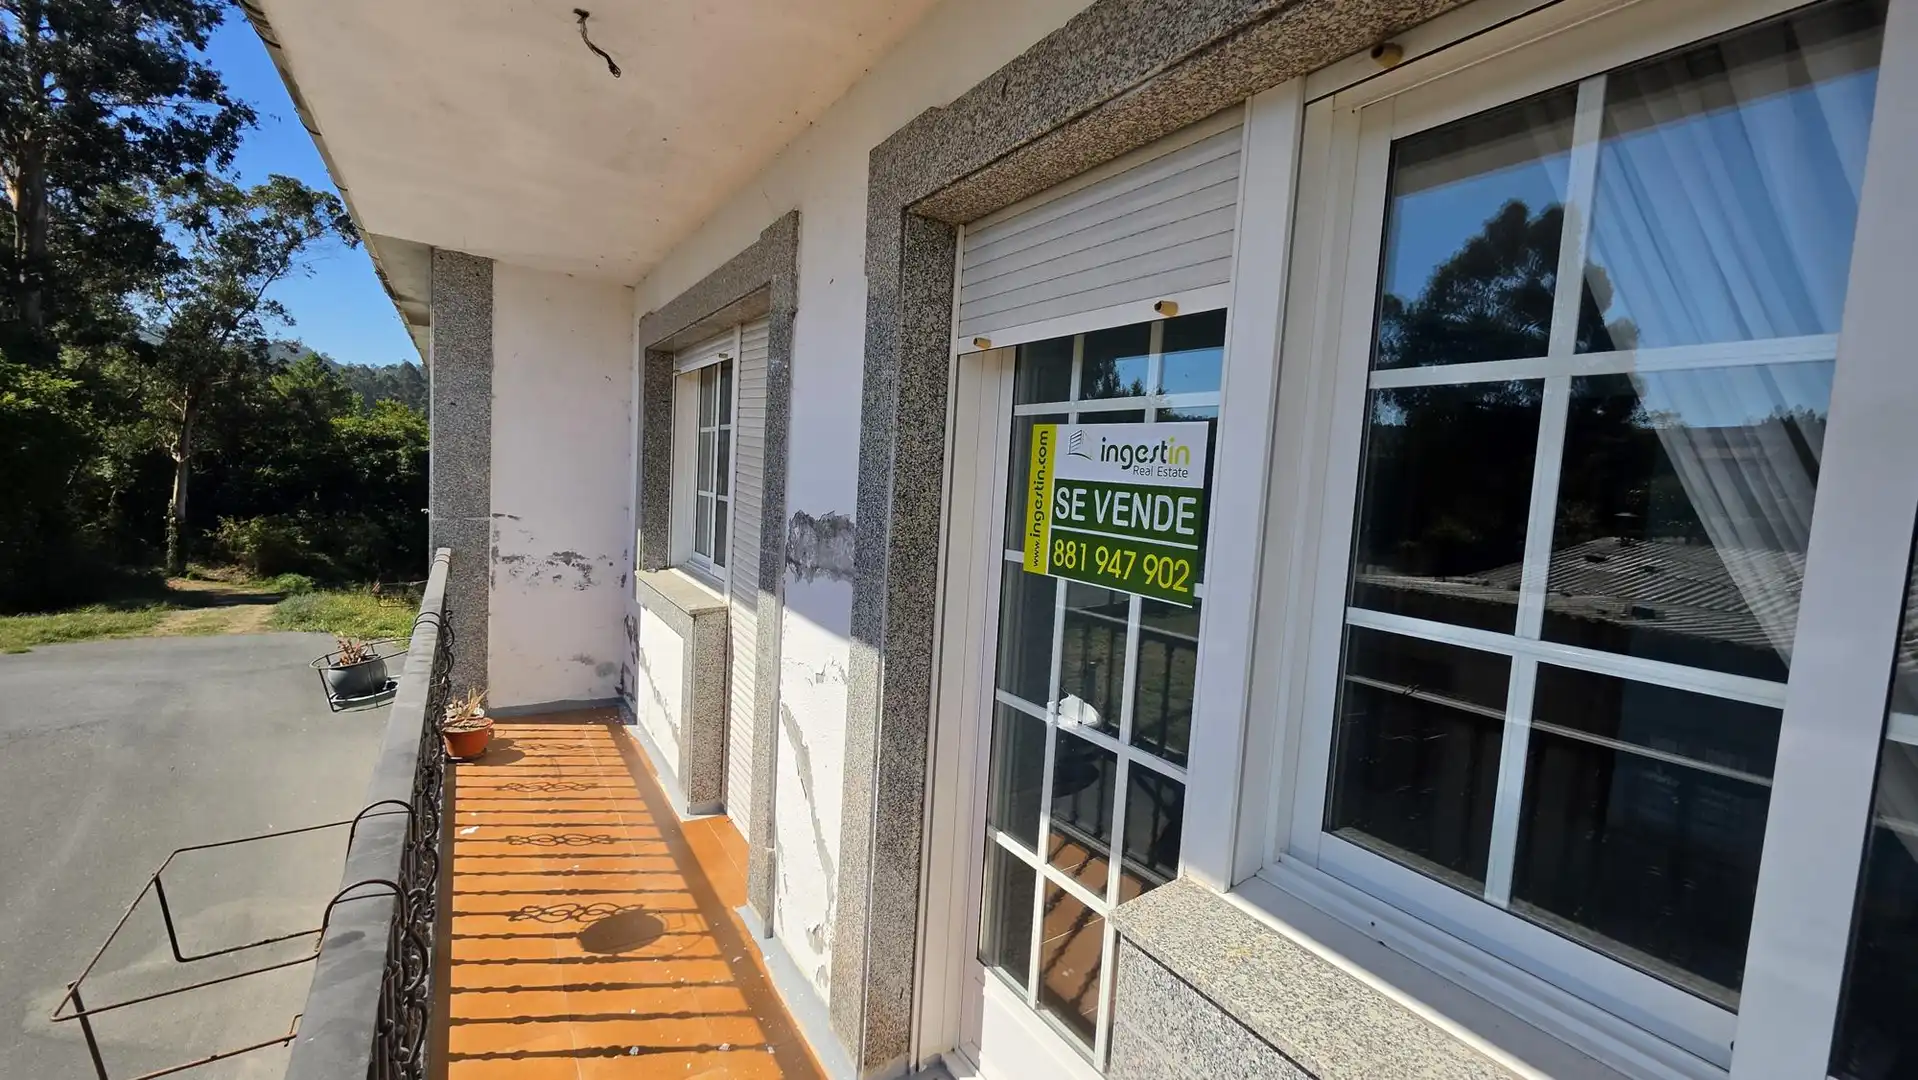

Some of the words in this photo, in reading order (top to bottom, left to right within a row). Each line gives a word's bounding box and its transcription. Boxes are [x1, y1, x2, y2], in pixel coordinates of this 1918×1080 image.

[1101, 436, 1190, 469] ingestin
[1133, 465, 1153, 477] Real
[1157, 467, 1188, 478] Estate
[1030, 430, 1049, 567] www.ingestin.com
[1055, 487, 1087, 521] SE
[1094, 489, 1197, 535] VENDE
[1053, 538, 1087, 571] 881
[1095, 545, 1137, 580] 947
[1143, 553, 1190, 593] 902
